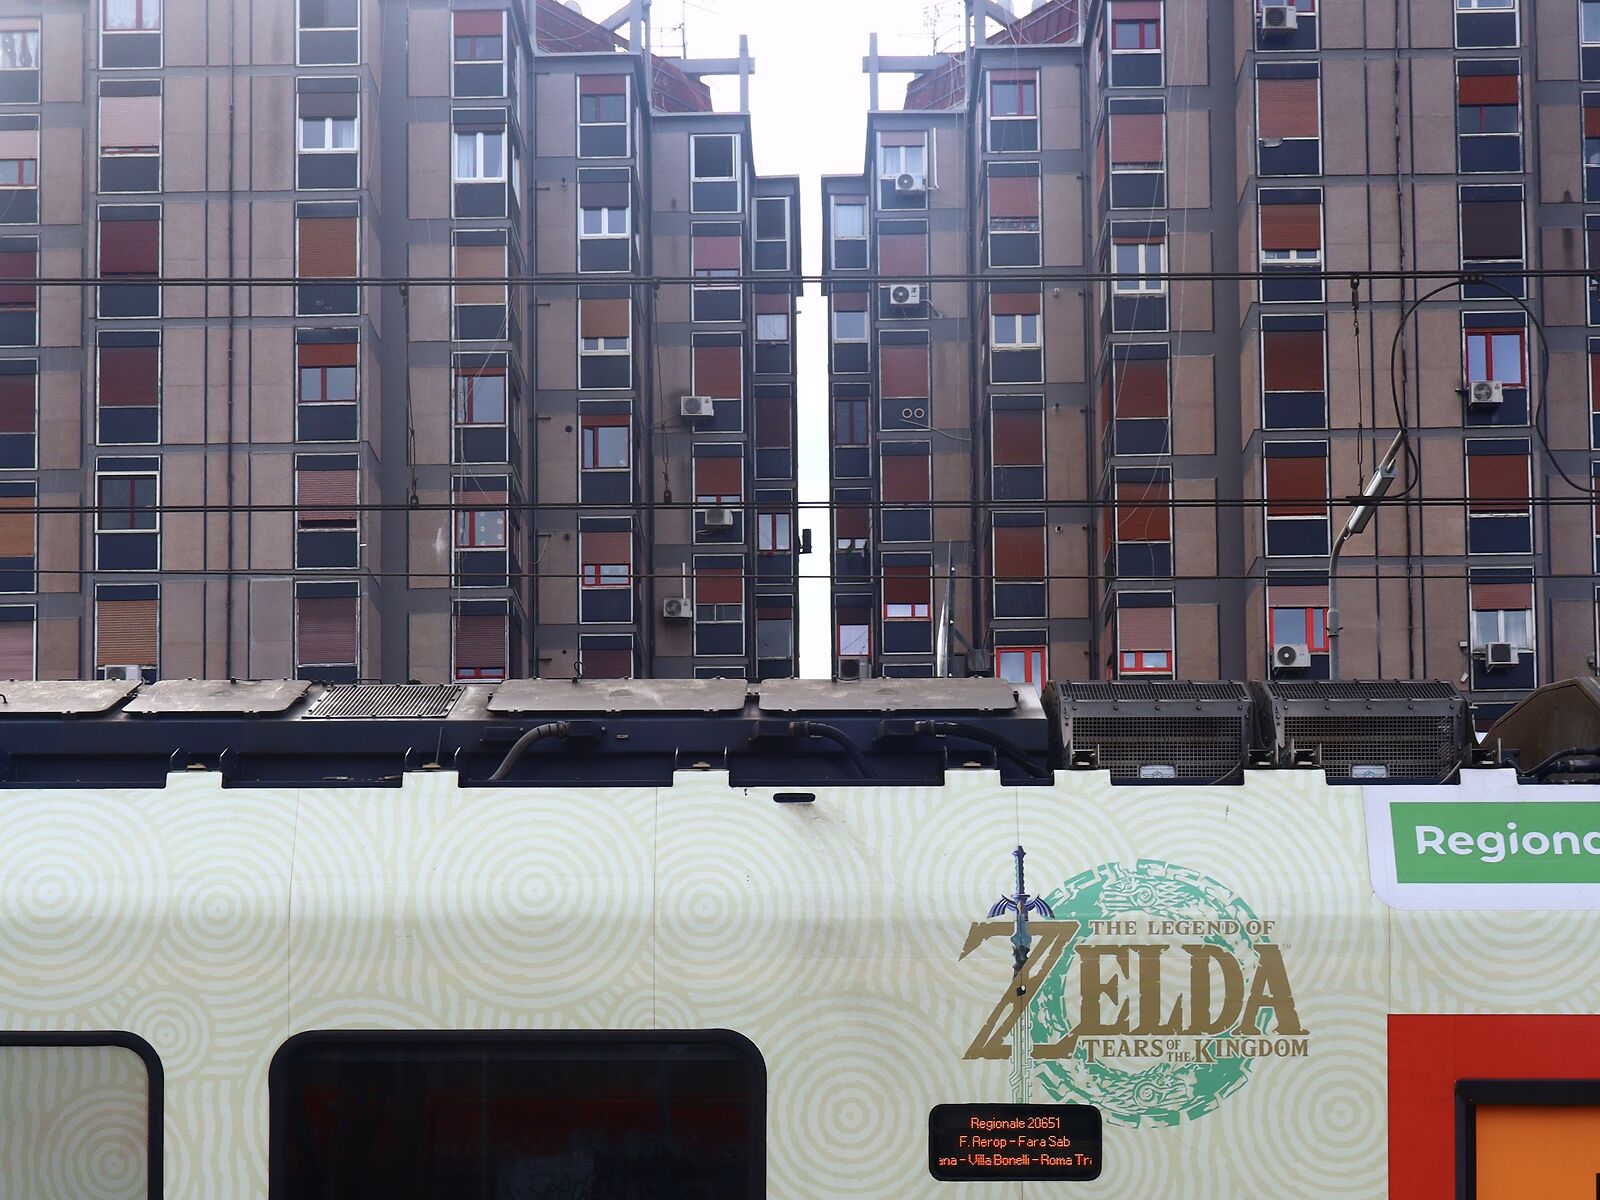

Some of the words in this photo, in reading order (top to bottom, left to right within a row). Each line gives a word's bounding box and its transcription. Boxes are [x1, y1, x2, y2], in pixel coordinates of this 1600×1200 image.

[1089, 920, 1137, 935] THE
[1148, 920, 1240, 935] LEGEND
[1245, 920, 1276, 935] OF
[958, 921, 1311, 1060] ZELDA
[1081, 1038, 1163, 1063] TEARS
[1166, 1039, 1182, 1049] OF
[1193, 1038, 1310, 1064] KINGDOM
[1166, 1052, 1191, 1062] THE
[970, 1116, 1026, 1131] Regionale
[1027, 1116, 1061, 1129] 20651
[959, 1135, 970, 1147] F.
[972, 1135, 1007, 1149] Aerop
[1018, 1135, 1046, 1147] Fara
[1048, 1135, 1071, 1147] Sab
[968, 1153, 992, 1166] Villa
[993, 1153, 1030, 1166] Bonelli
[1041, 1153, 1073, 1166] Roma
